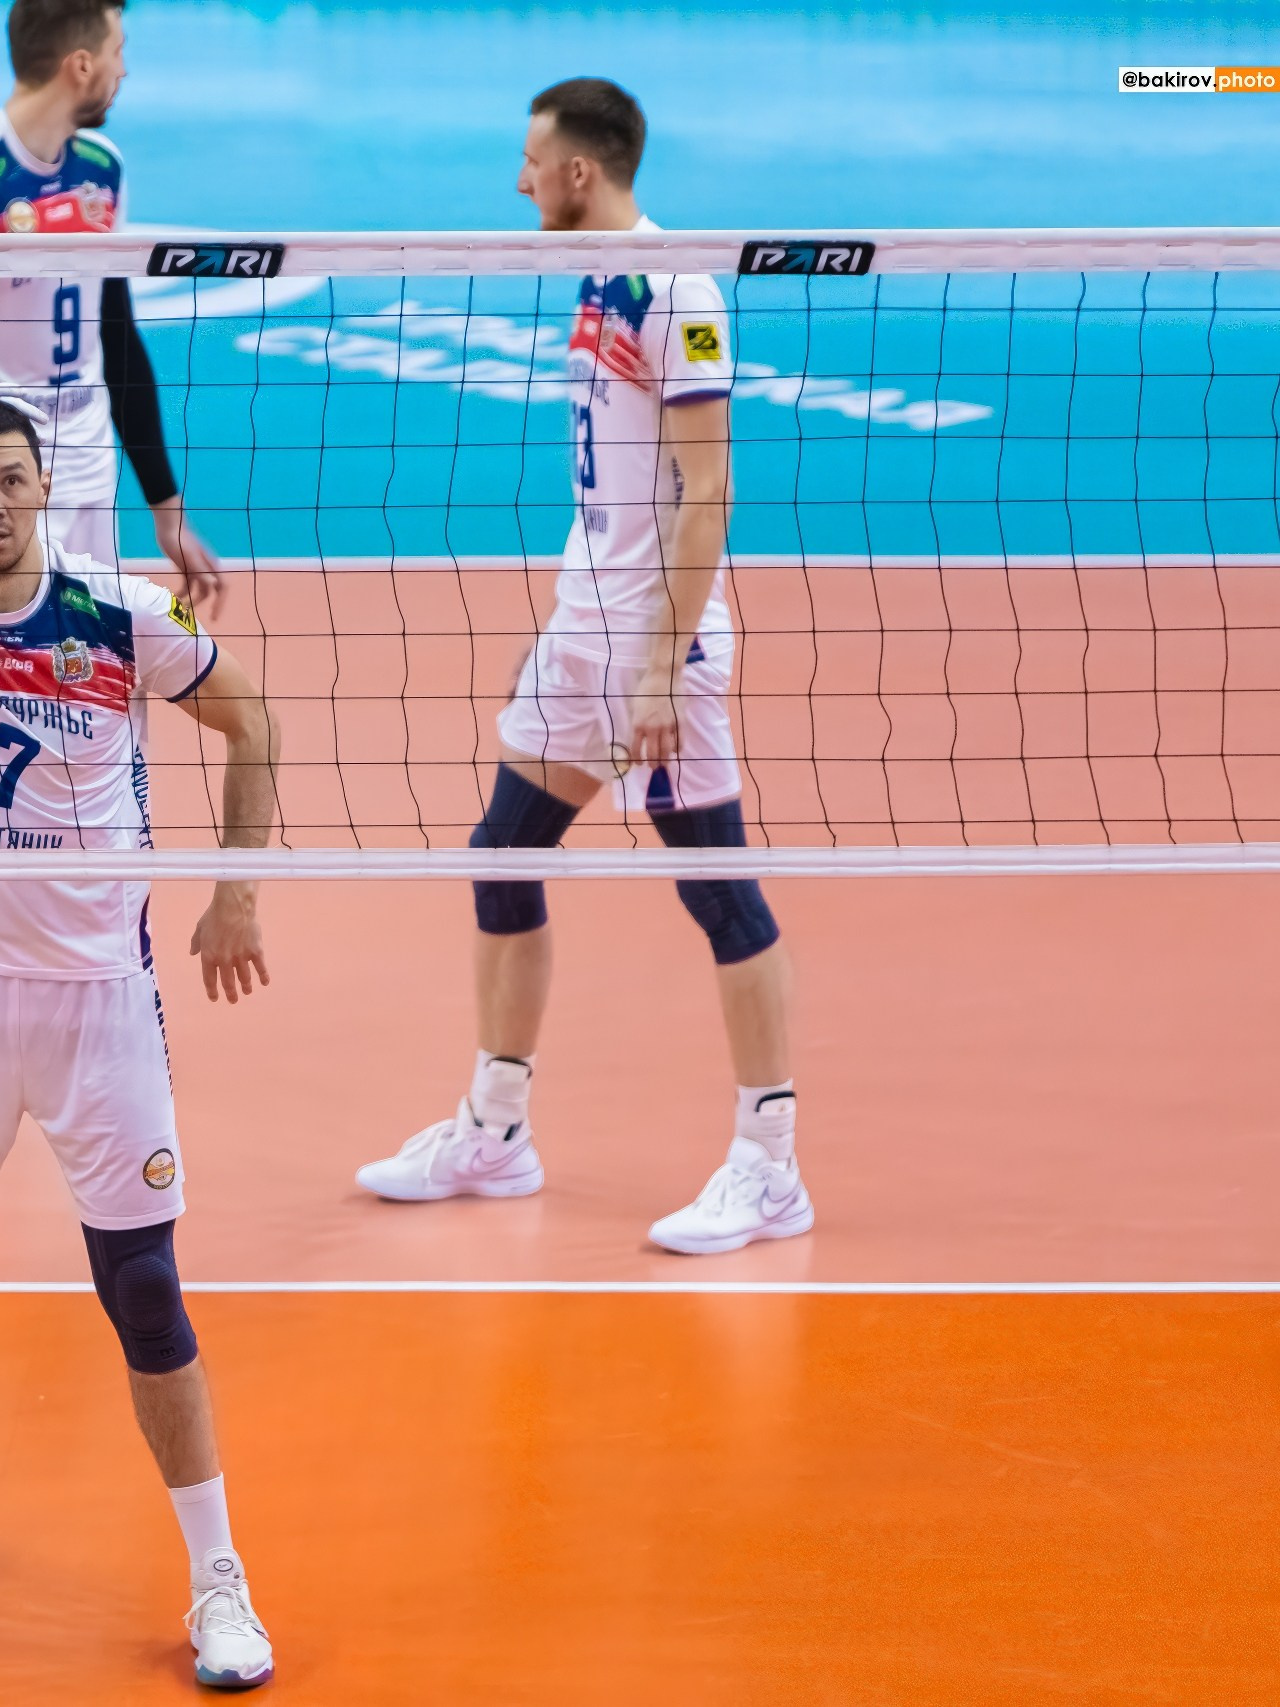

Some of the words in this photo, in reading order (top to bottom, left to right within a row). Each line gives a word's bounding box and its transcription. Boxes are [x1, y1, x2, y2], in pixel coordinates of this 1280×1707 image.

[160, 248, 272, 275] PARI
[750, 247, 863, 273] PARI
[53, 283, 81, 364] 9
